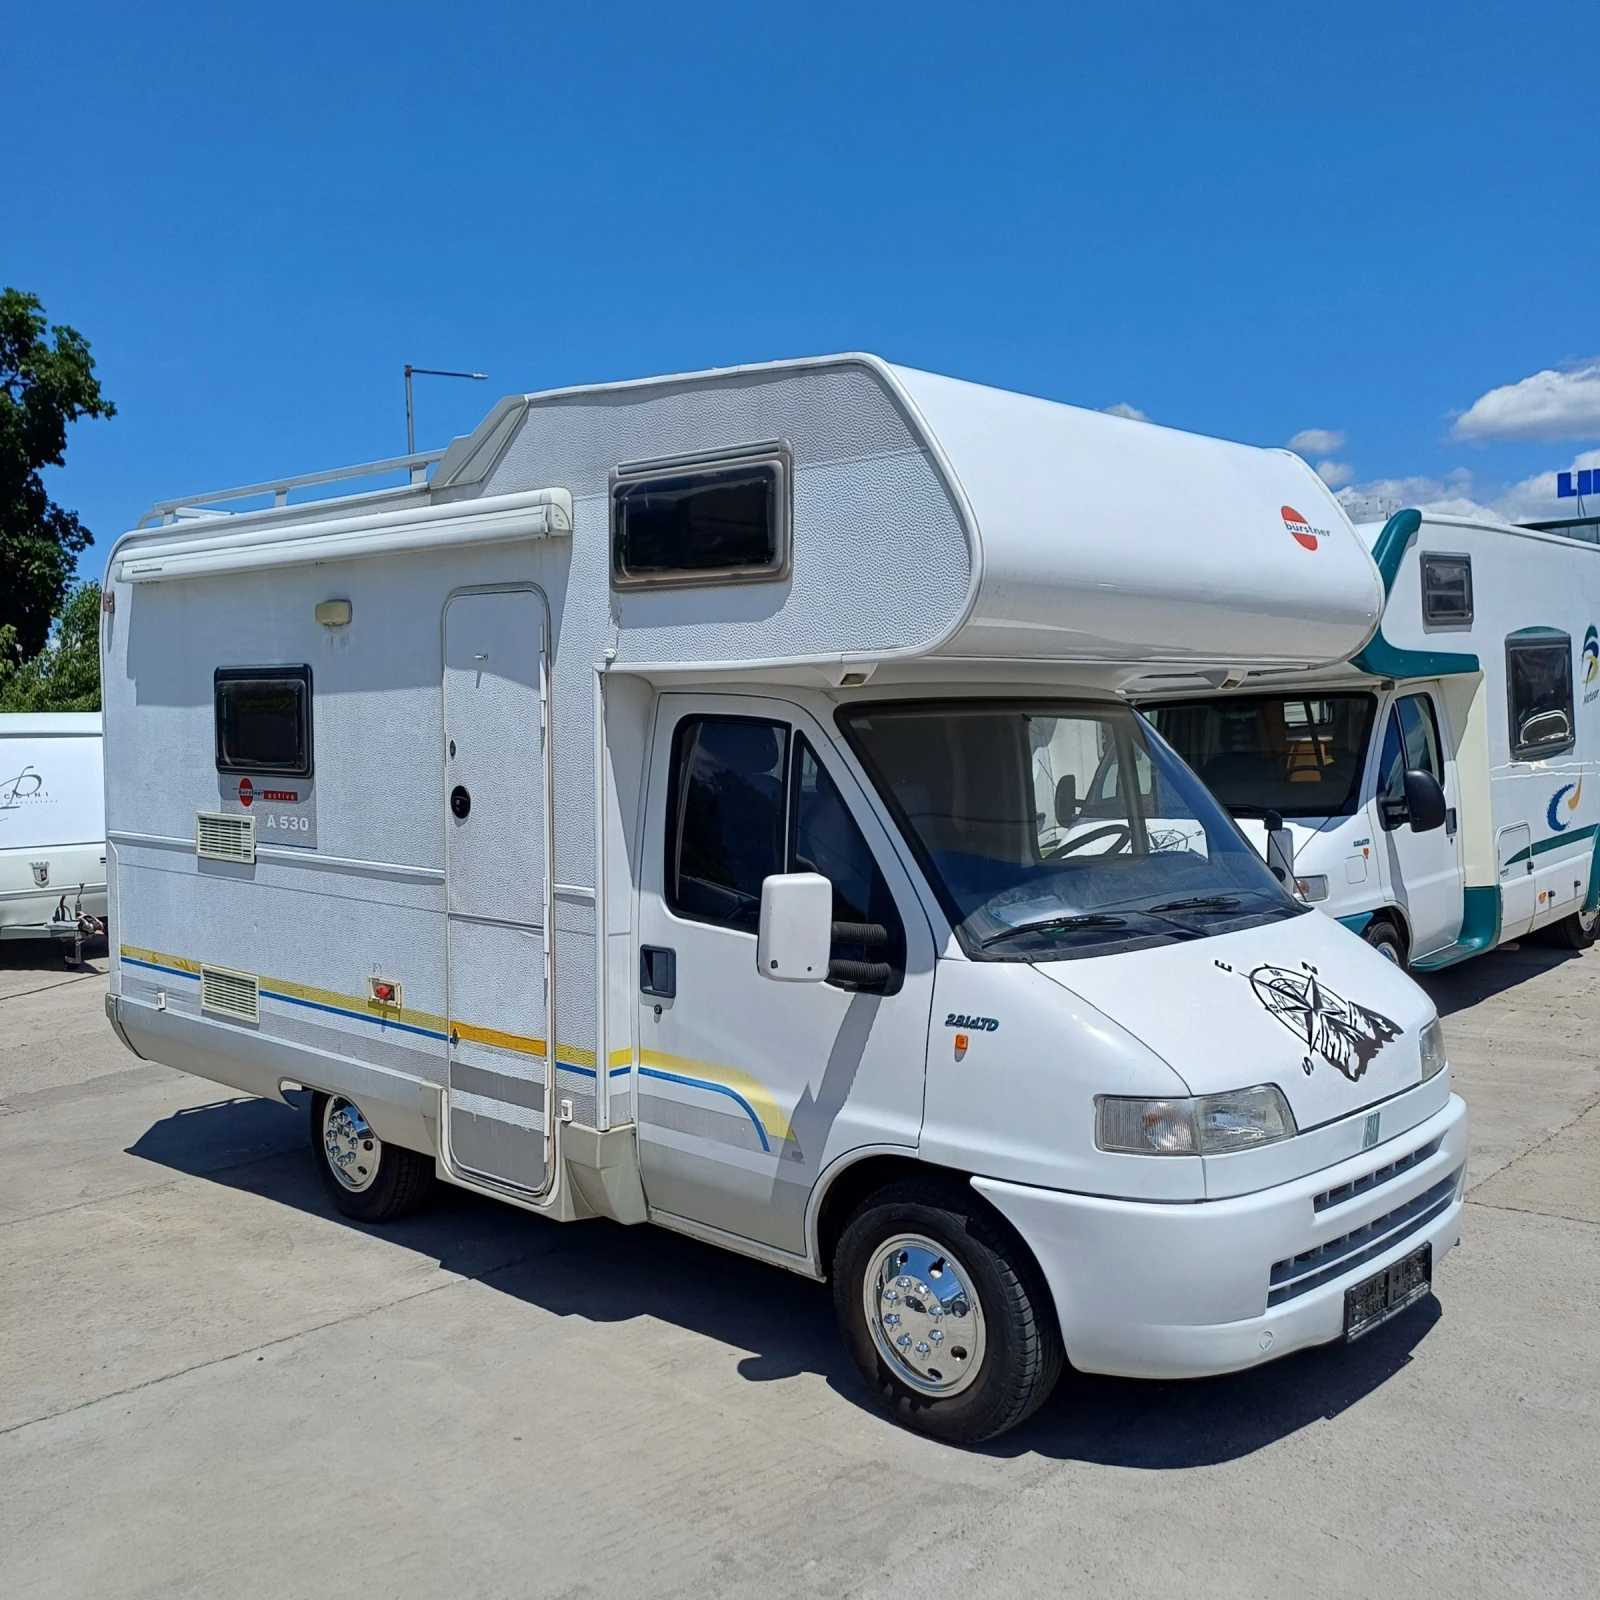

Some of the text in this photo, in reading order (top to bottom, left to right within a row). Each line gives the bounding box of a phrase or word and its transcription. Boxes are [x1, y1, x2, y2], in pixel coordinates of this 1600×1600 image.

[1284, 521, 1331, 537] bürstner
[238, 788, 295, 801] bürstner active
[267, 814, 309, 831] A 530
